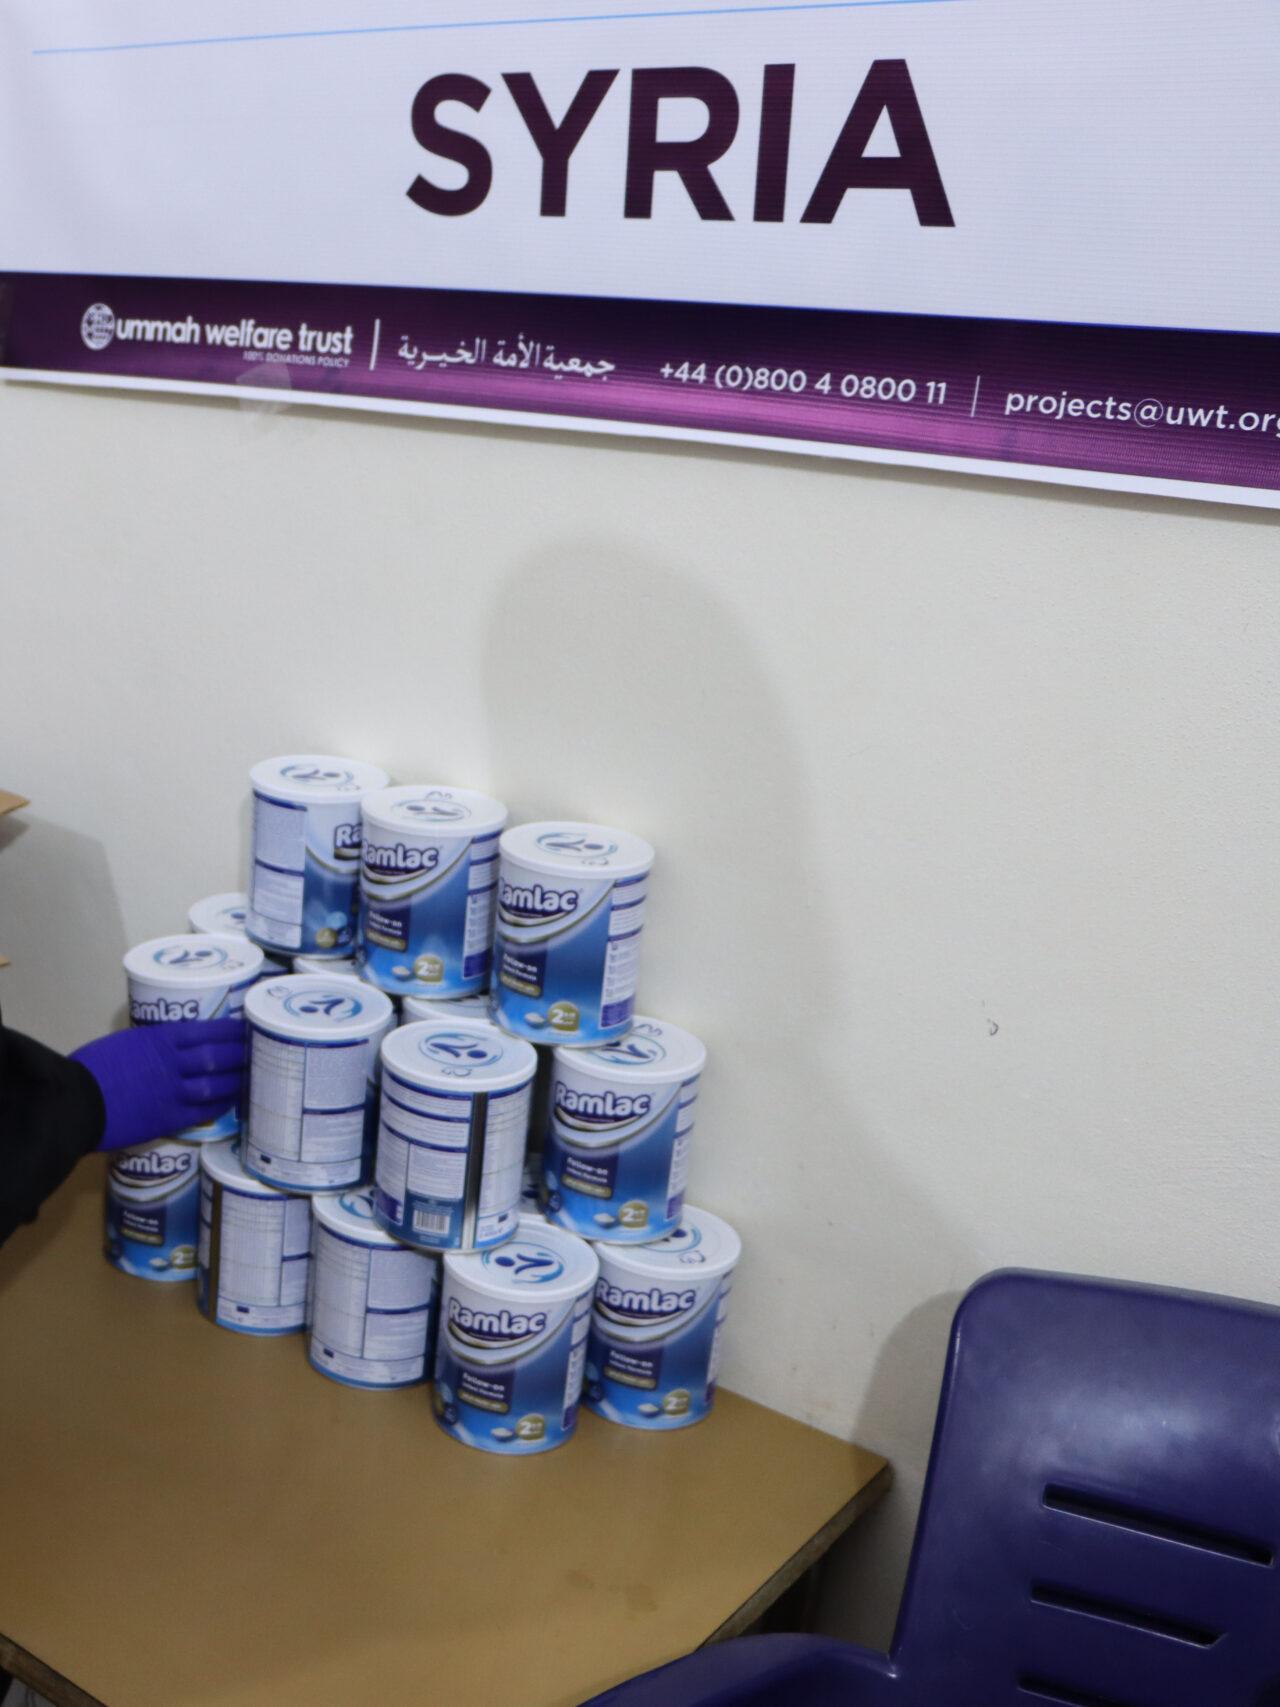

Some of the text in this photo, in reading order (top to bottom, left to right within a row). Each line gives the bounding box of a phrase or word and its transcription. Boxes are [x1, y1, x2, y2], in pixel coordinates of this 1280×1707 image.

[405, 59, 956, 228] SYRIA
[116, 315, 353, 354] ummah welfare trust
[266, 352, 316, 366] DONATIONS
[317, 356, 351, 368] POLICY
[543, 345, 615, 381] جمعية
[660, 361, 947, 404] +44 (0)800 4 0800 11
[1005, 391, 1280, 438] projects@uwt.or
[500, 881, 578, 911] amlac
[131, 999, 199, 1021] amlac
[551, 1008, 564, 1025] 2
[556, 1082, 651, 1116] Ramlac
[621, 1207, 635, 1222] 2
[595, 1279, 696, 1312] Ramlac
[449, 1298, 547, 1334] Ramlac
[521, 1421, 532, 1435] 2
